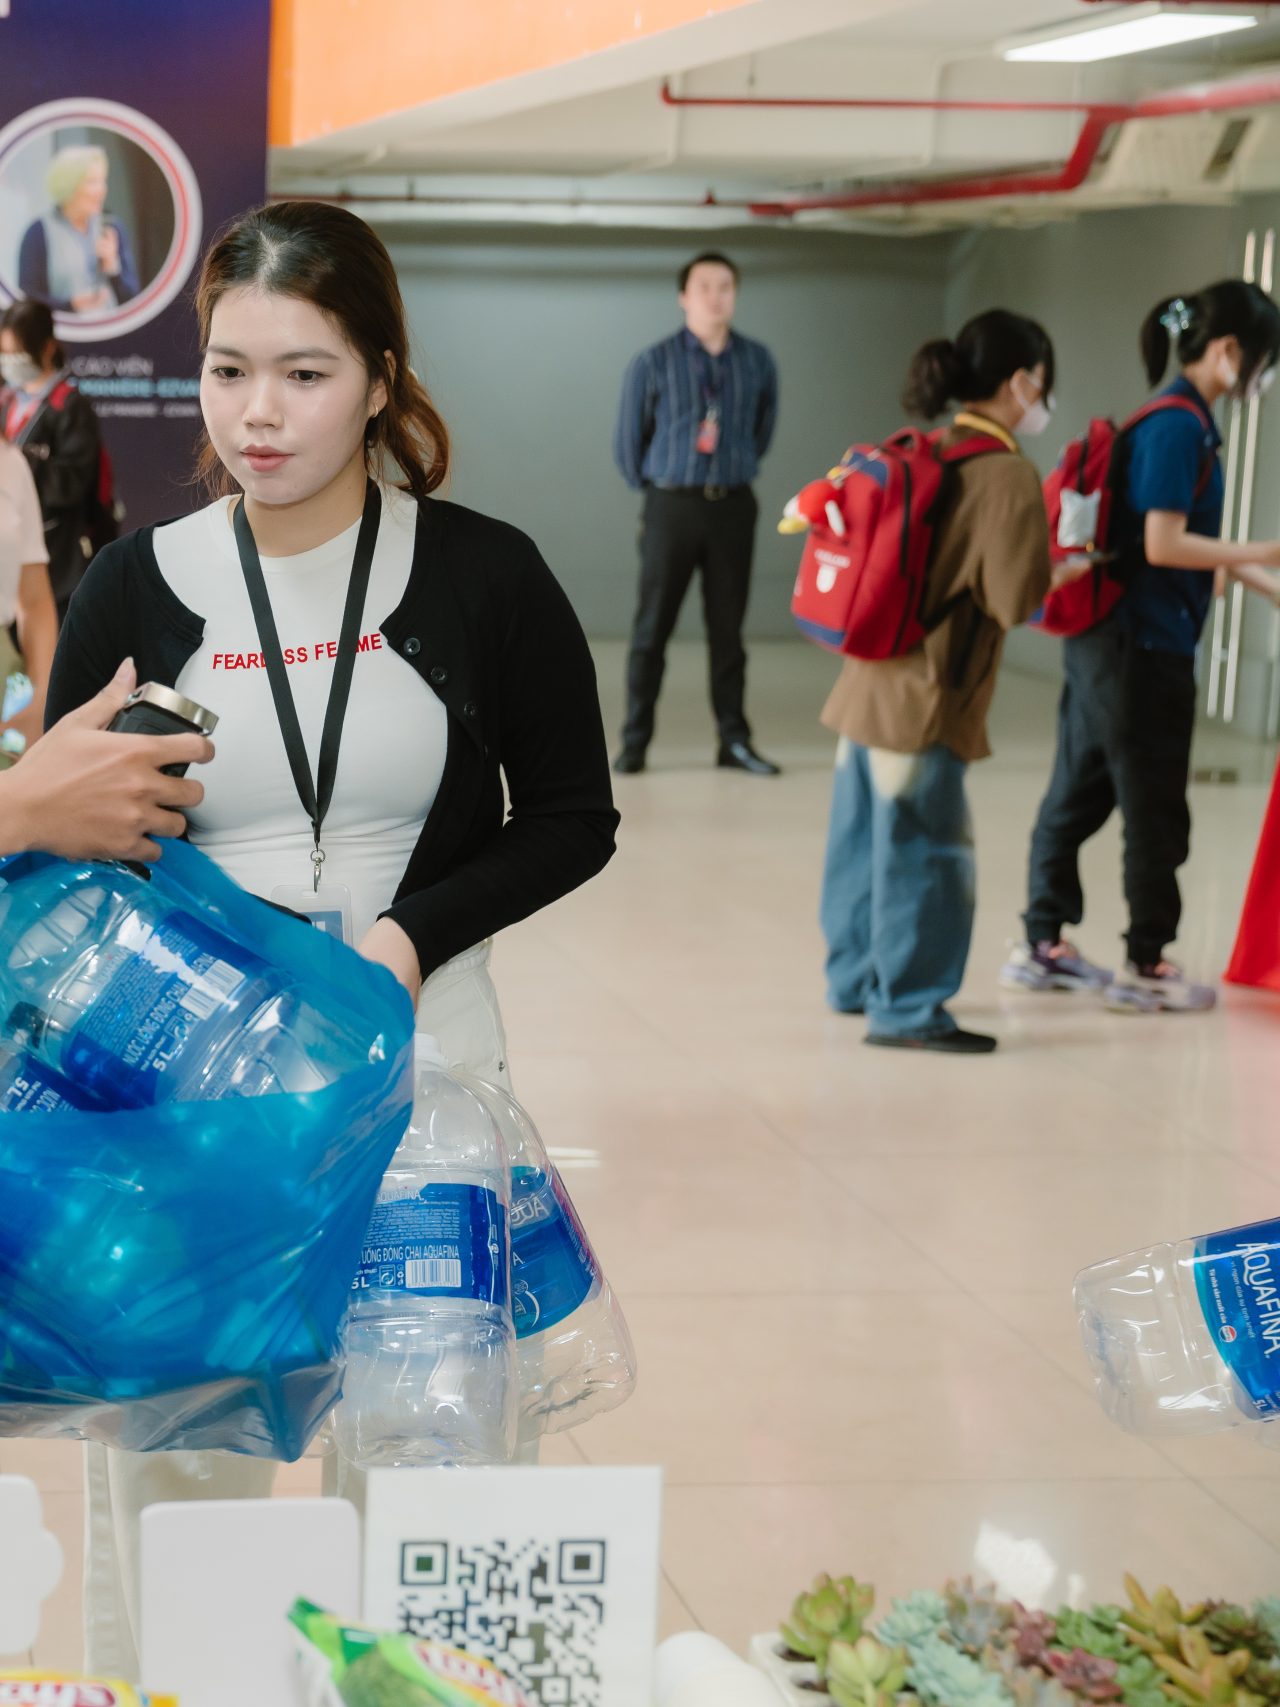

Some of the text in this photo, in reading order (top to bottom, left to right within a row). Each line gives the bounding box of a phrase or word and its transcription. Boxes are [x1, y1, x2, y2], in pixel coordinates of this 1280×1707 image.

[213, 633, 382, 670] FEARLSS FEME
[405, 1245, 421, 1260] CHAI
[423, 1245, 460, 1259] AQUAFINA
[1235, 1240, 1280, 1357] AQUAFINA
